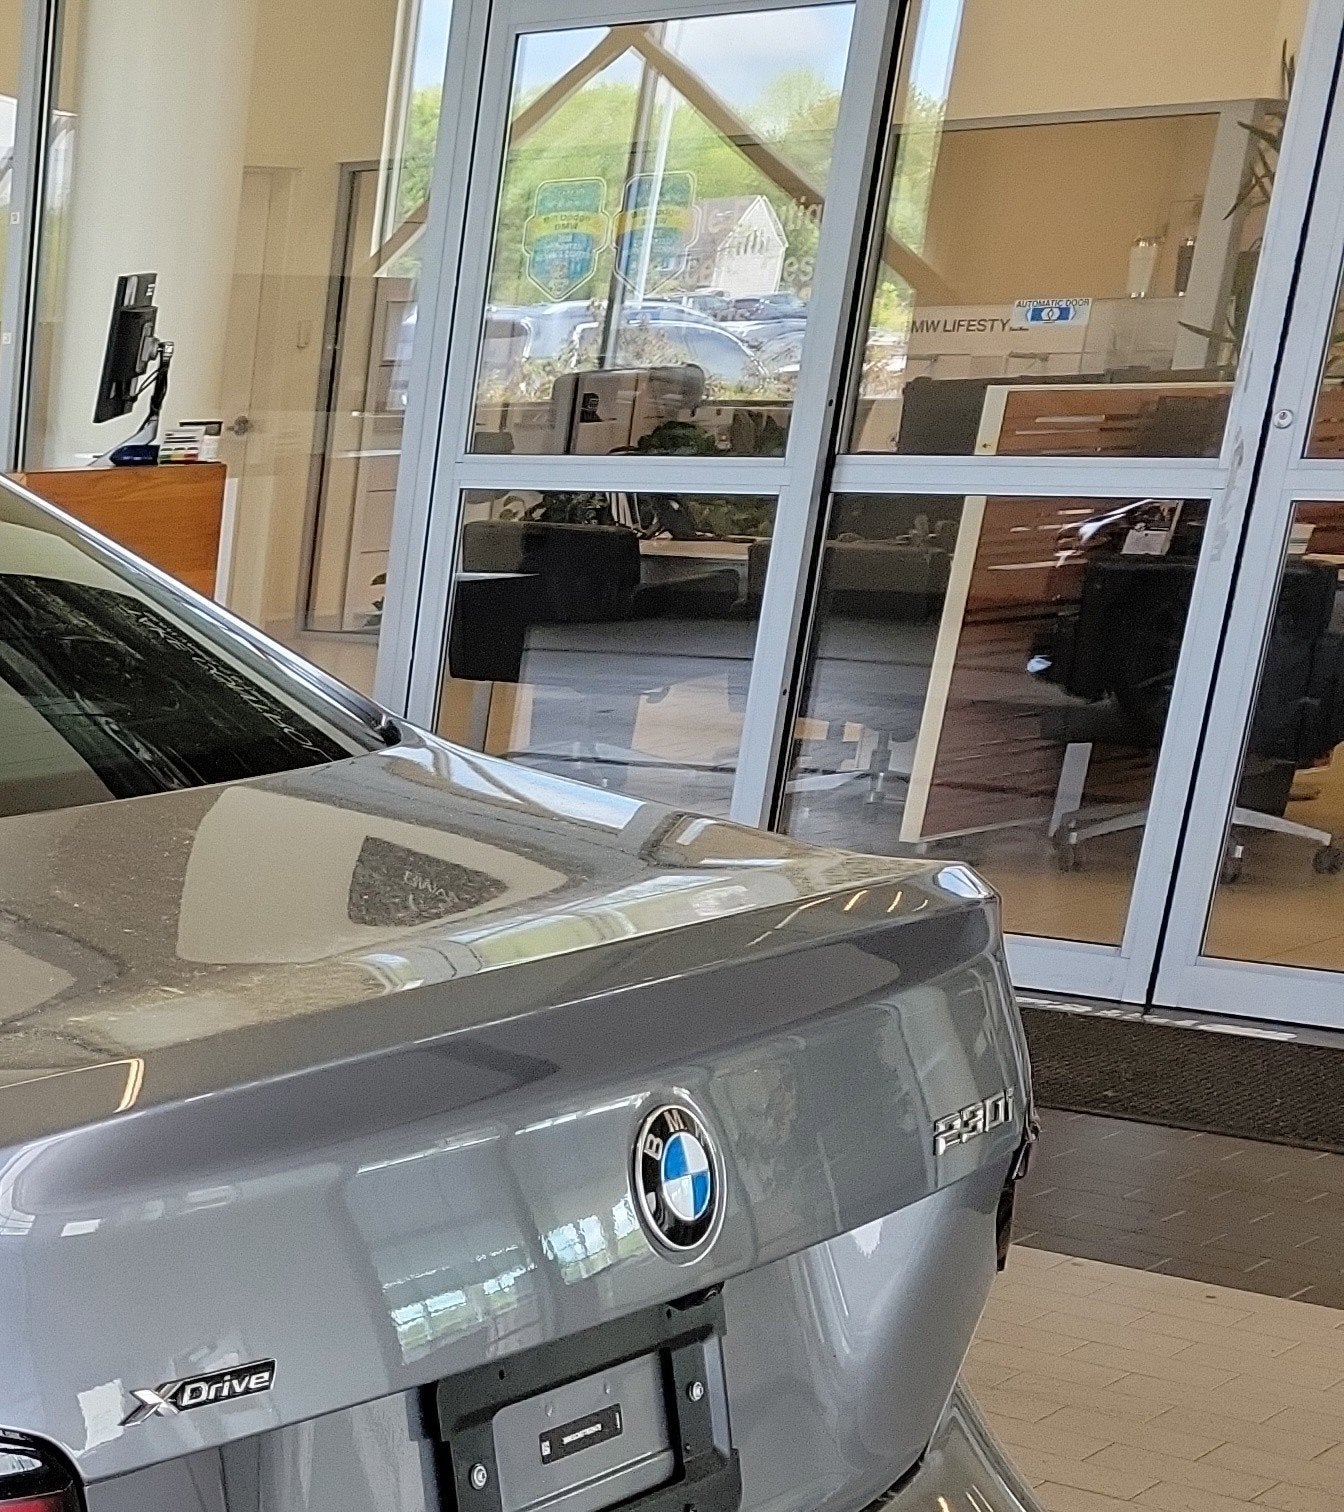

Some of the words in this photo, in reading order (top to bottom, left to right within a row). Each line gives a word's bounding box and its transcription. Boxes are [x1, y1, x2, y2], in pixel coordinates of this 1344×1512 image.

[1016, 300, 1062, 308] AUTOMATIC
[1065, 298, 1089, 307] DOOR
[911, 320, 939, 334] MW
[943, 318, 1029, 333] LIFESTY
[934, 1088, 1014, 1155] 230i
